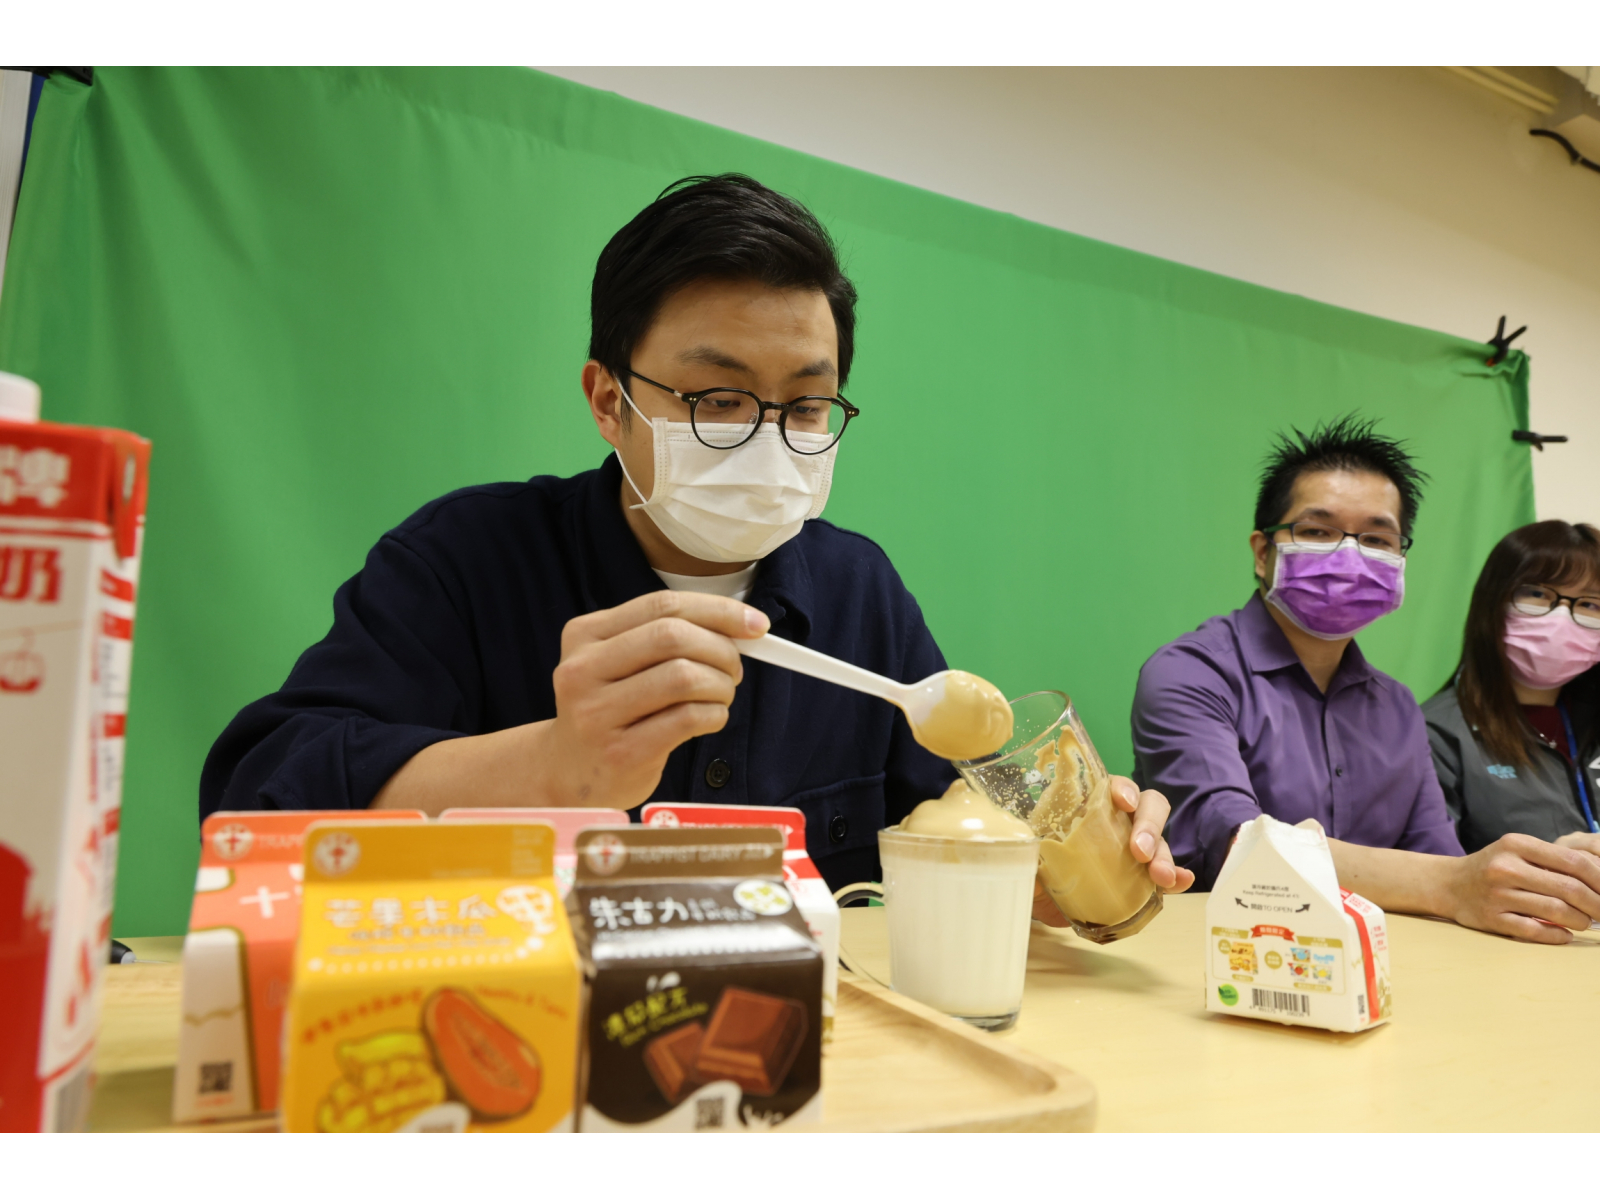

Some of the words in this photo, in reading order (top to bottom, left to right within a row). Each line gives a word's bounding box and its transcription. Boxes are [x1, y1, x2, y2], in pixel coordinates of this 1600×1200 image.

[325, 896, 498, 930] 芒果木瓜
[590, 895, 690, 930] 朱古力
